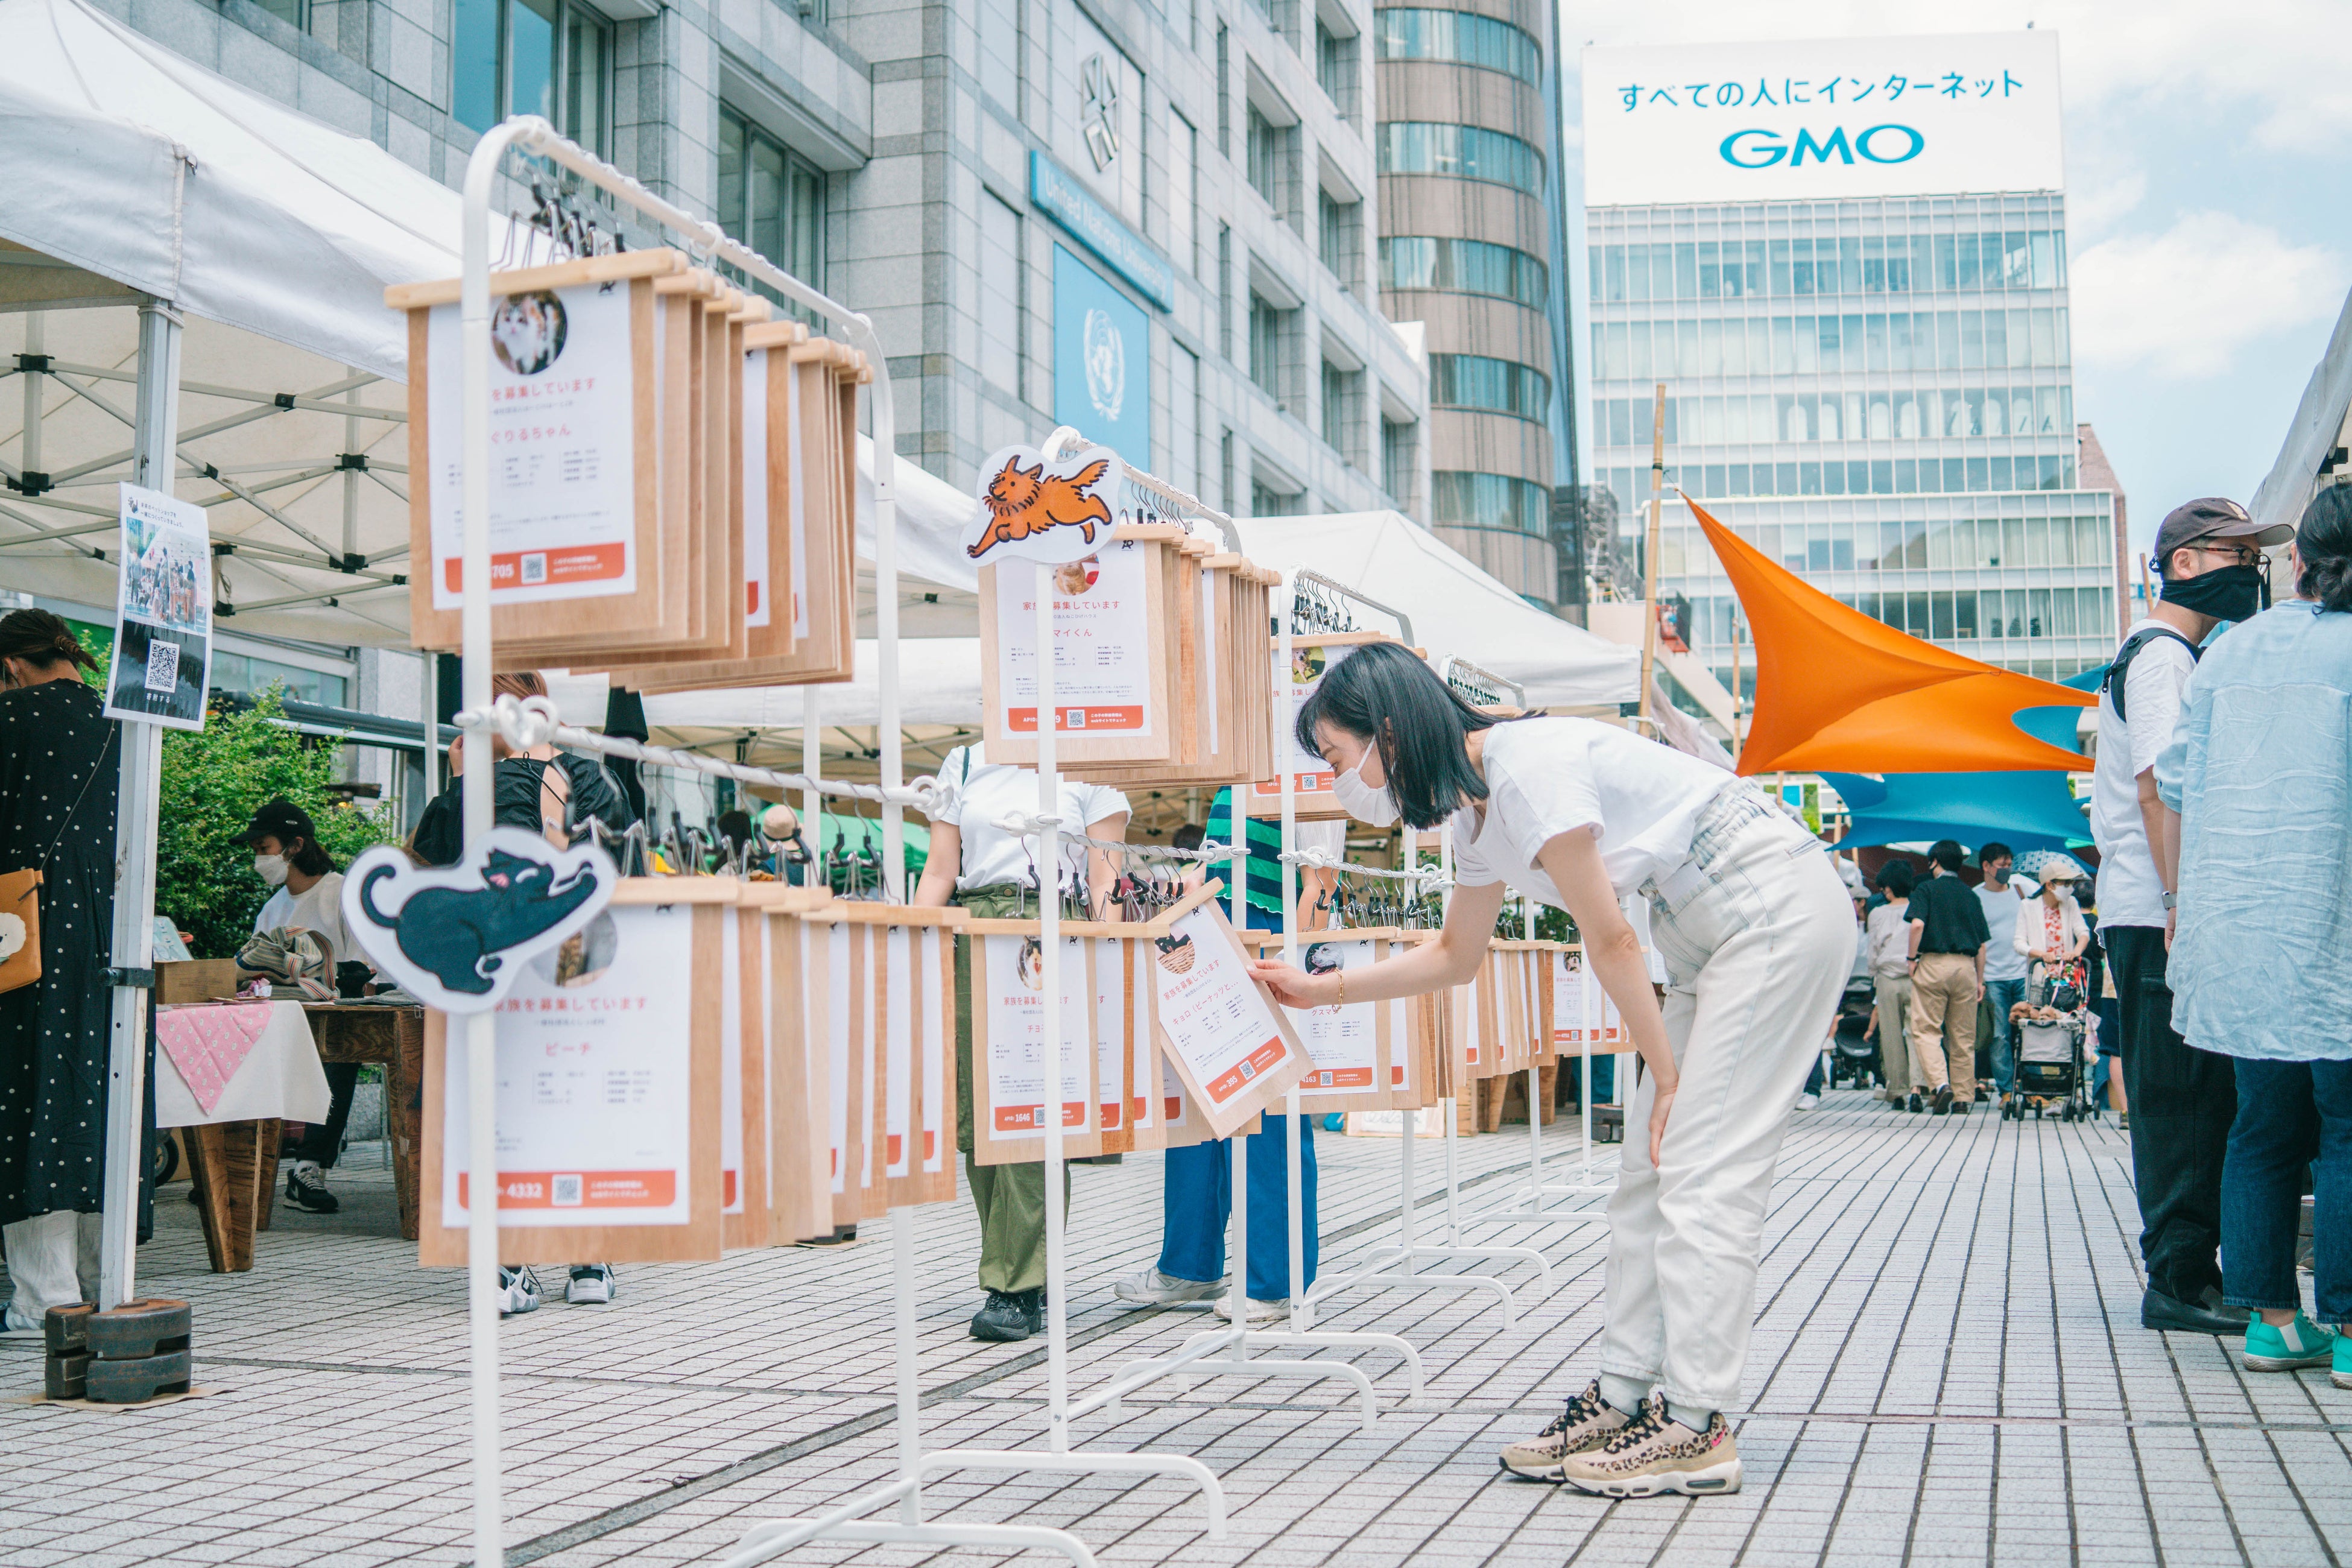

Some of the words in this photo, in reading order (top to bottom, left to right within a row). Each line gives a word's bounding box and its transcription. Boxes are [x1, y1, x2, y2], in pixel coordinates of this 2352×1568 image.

[1618, 69, 2023, 112] すべての人にインターネット
[1719, 124, 1924, 168] GMO
[1045, 169, 1081, 221] United
[1083, 201, 1121, 256] Nations
[1122, 235, 1166, 300] University
[1163, 959, 1220, 1001] 家族を募集しています
[1027, 1024, 1043, 1033] チヨ
[1226, 1075, 1238, 1087] 395
[1015, 1113, 1030, 1122] 1646
[507, 1181, 543, 1199] 4332
